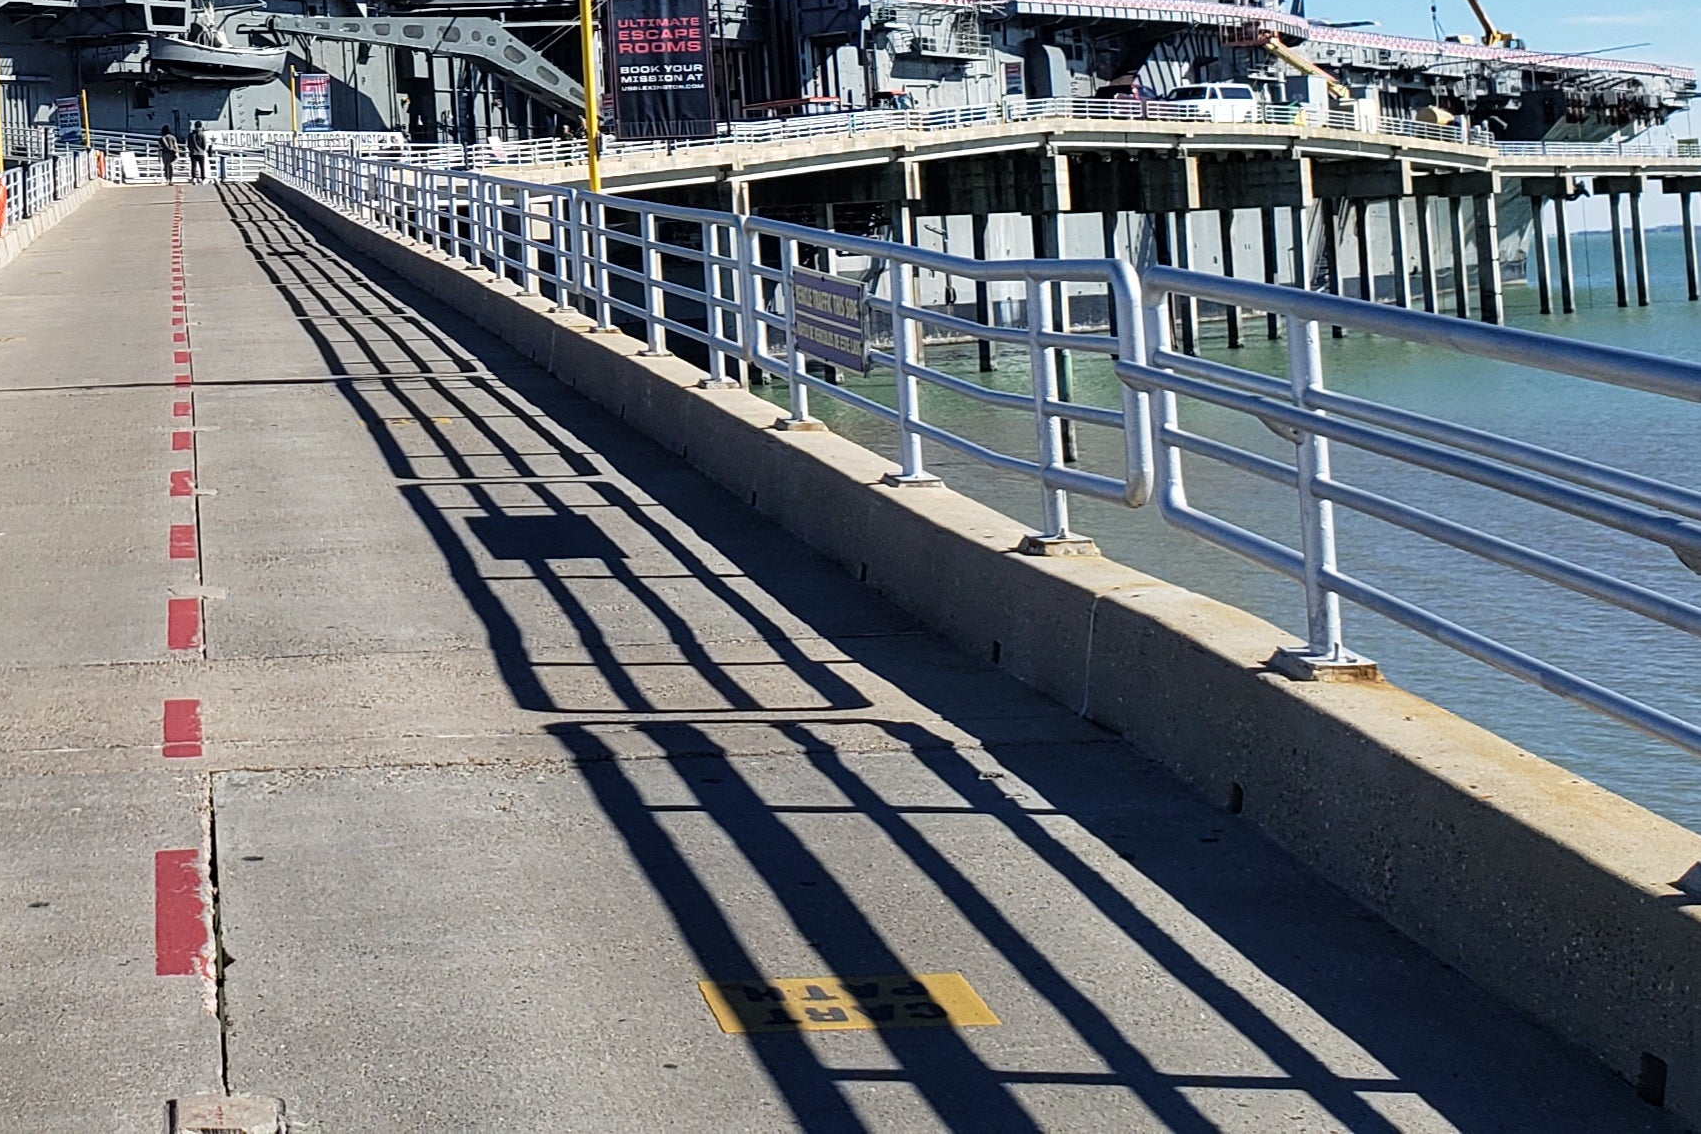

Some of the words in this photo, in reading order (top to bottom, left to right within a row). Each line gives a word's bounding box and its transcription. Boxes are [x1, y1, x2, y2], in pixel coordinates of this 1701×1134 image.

[618, 17, 700, 28] ULTIMATE
[618, 28, 701, 40] ESCAPE
[619, 40, 702, 54] ROOMS
[620, 65, 660, 74] BOOK
[664, 64, 703, 73] YOUR
[620, 74, 683, 83] MISSION
[686, 73, 703, 82] AT
[220, 132, 265, 147] WELCOME
[306, 133, 321, 147] THE
[742, 981, 929, 1001] PATH
[764, 1001, 948, 1024] CART
